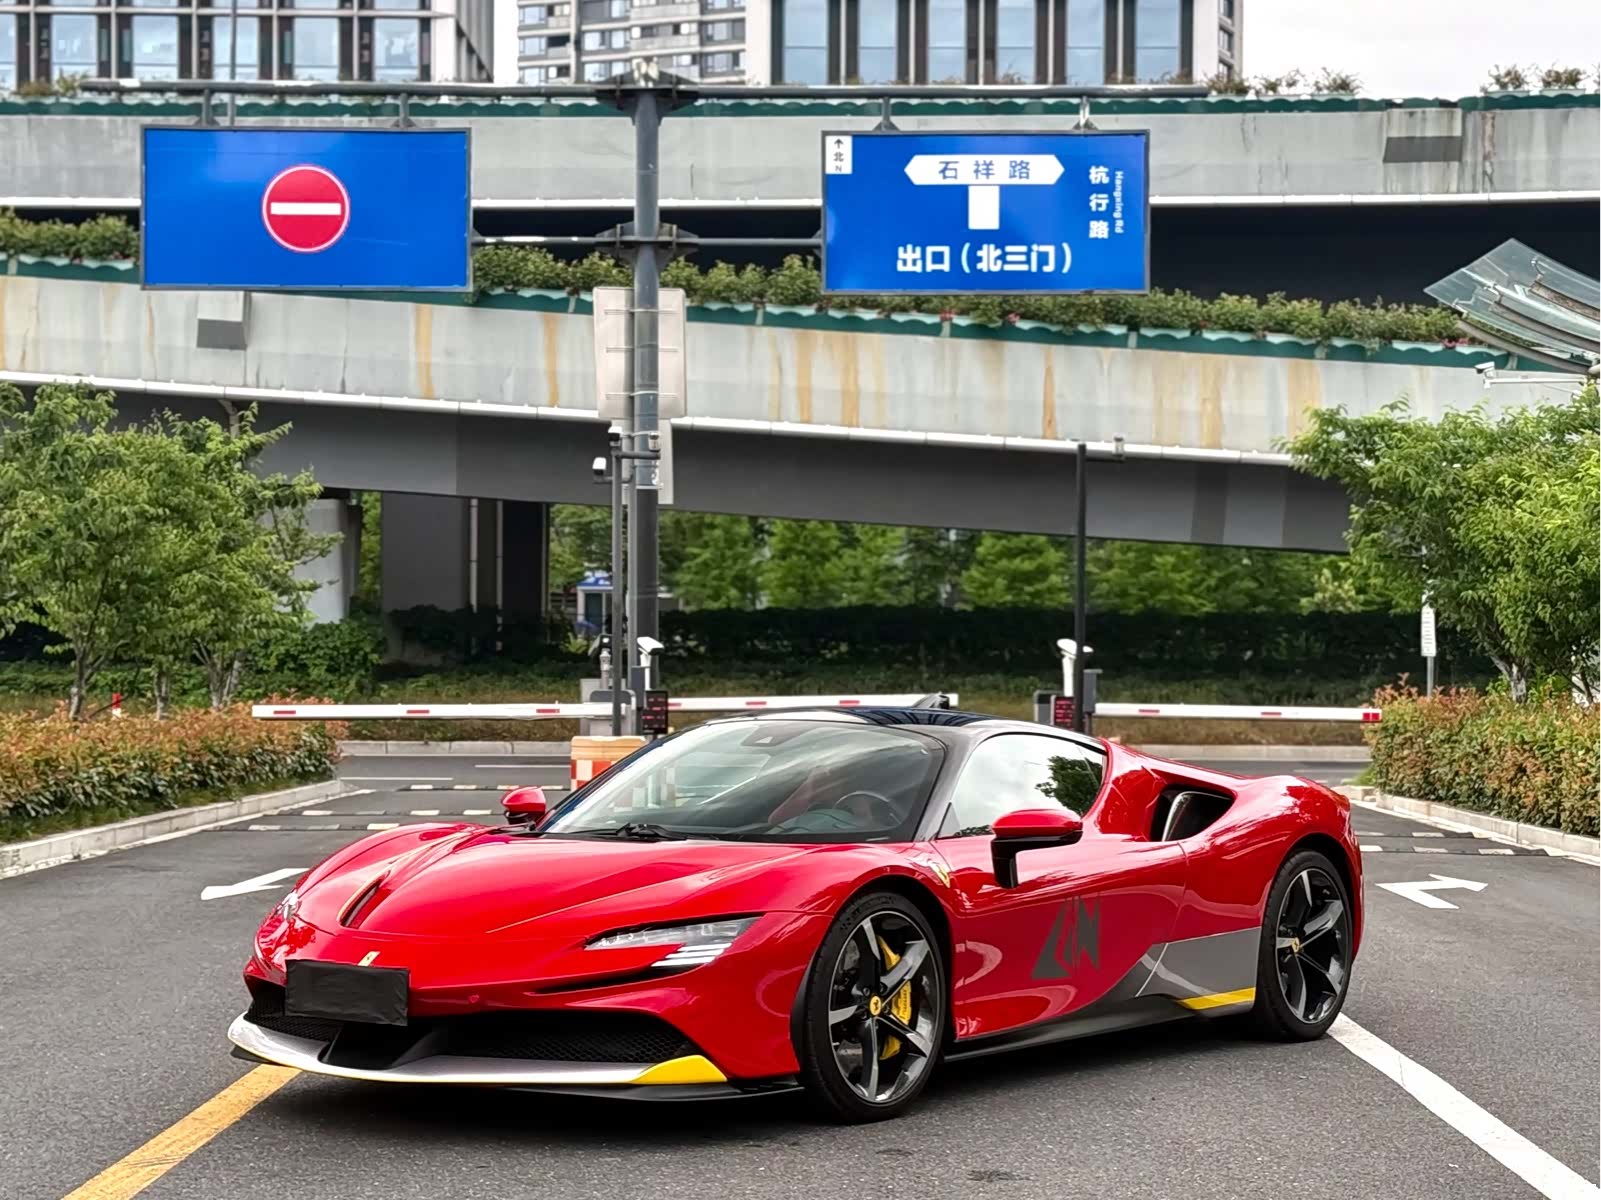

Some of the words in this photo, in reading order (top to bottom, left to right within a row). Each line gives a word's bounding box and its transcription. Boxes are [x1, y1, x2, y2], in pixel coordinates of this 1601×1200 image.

[833, 151, 844, 162] 北
[938, 159, 1030, 180] 石祥路
[1088, 165, 1110, 239] 杭行路
[1112, 170, 1124, 218] Hangxing
[1114, 219, 1124, 234] Rd
